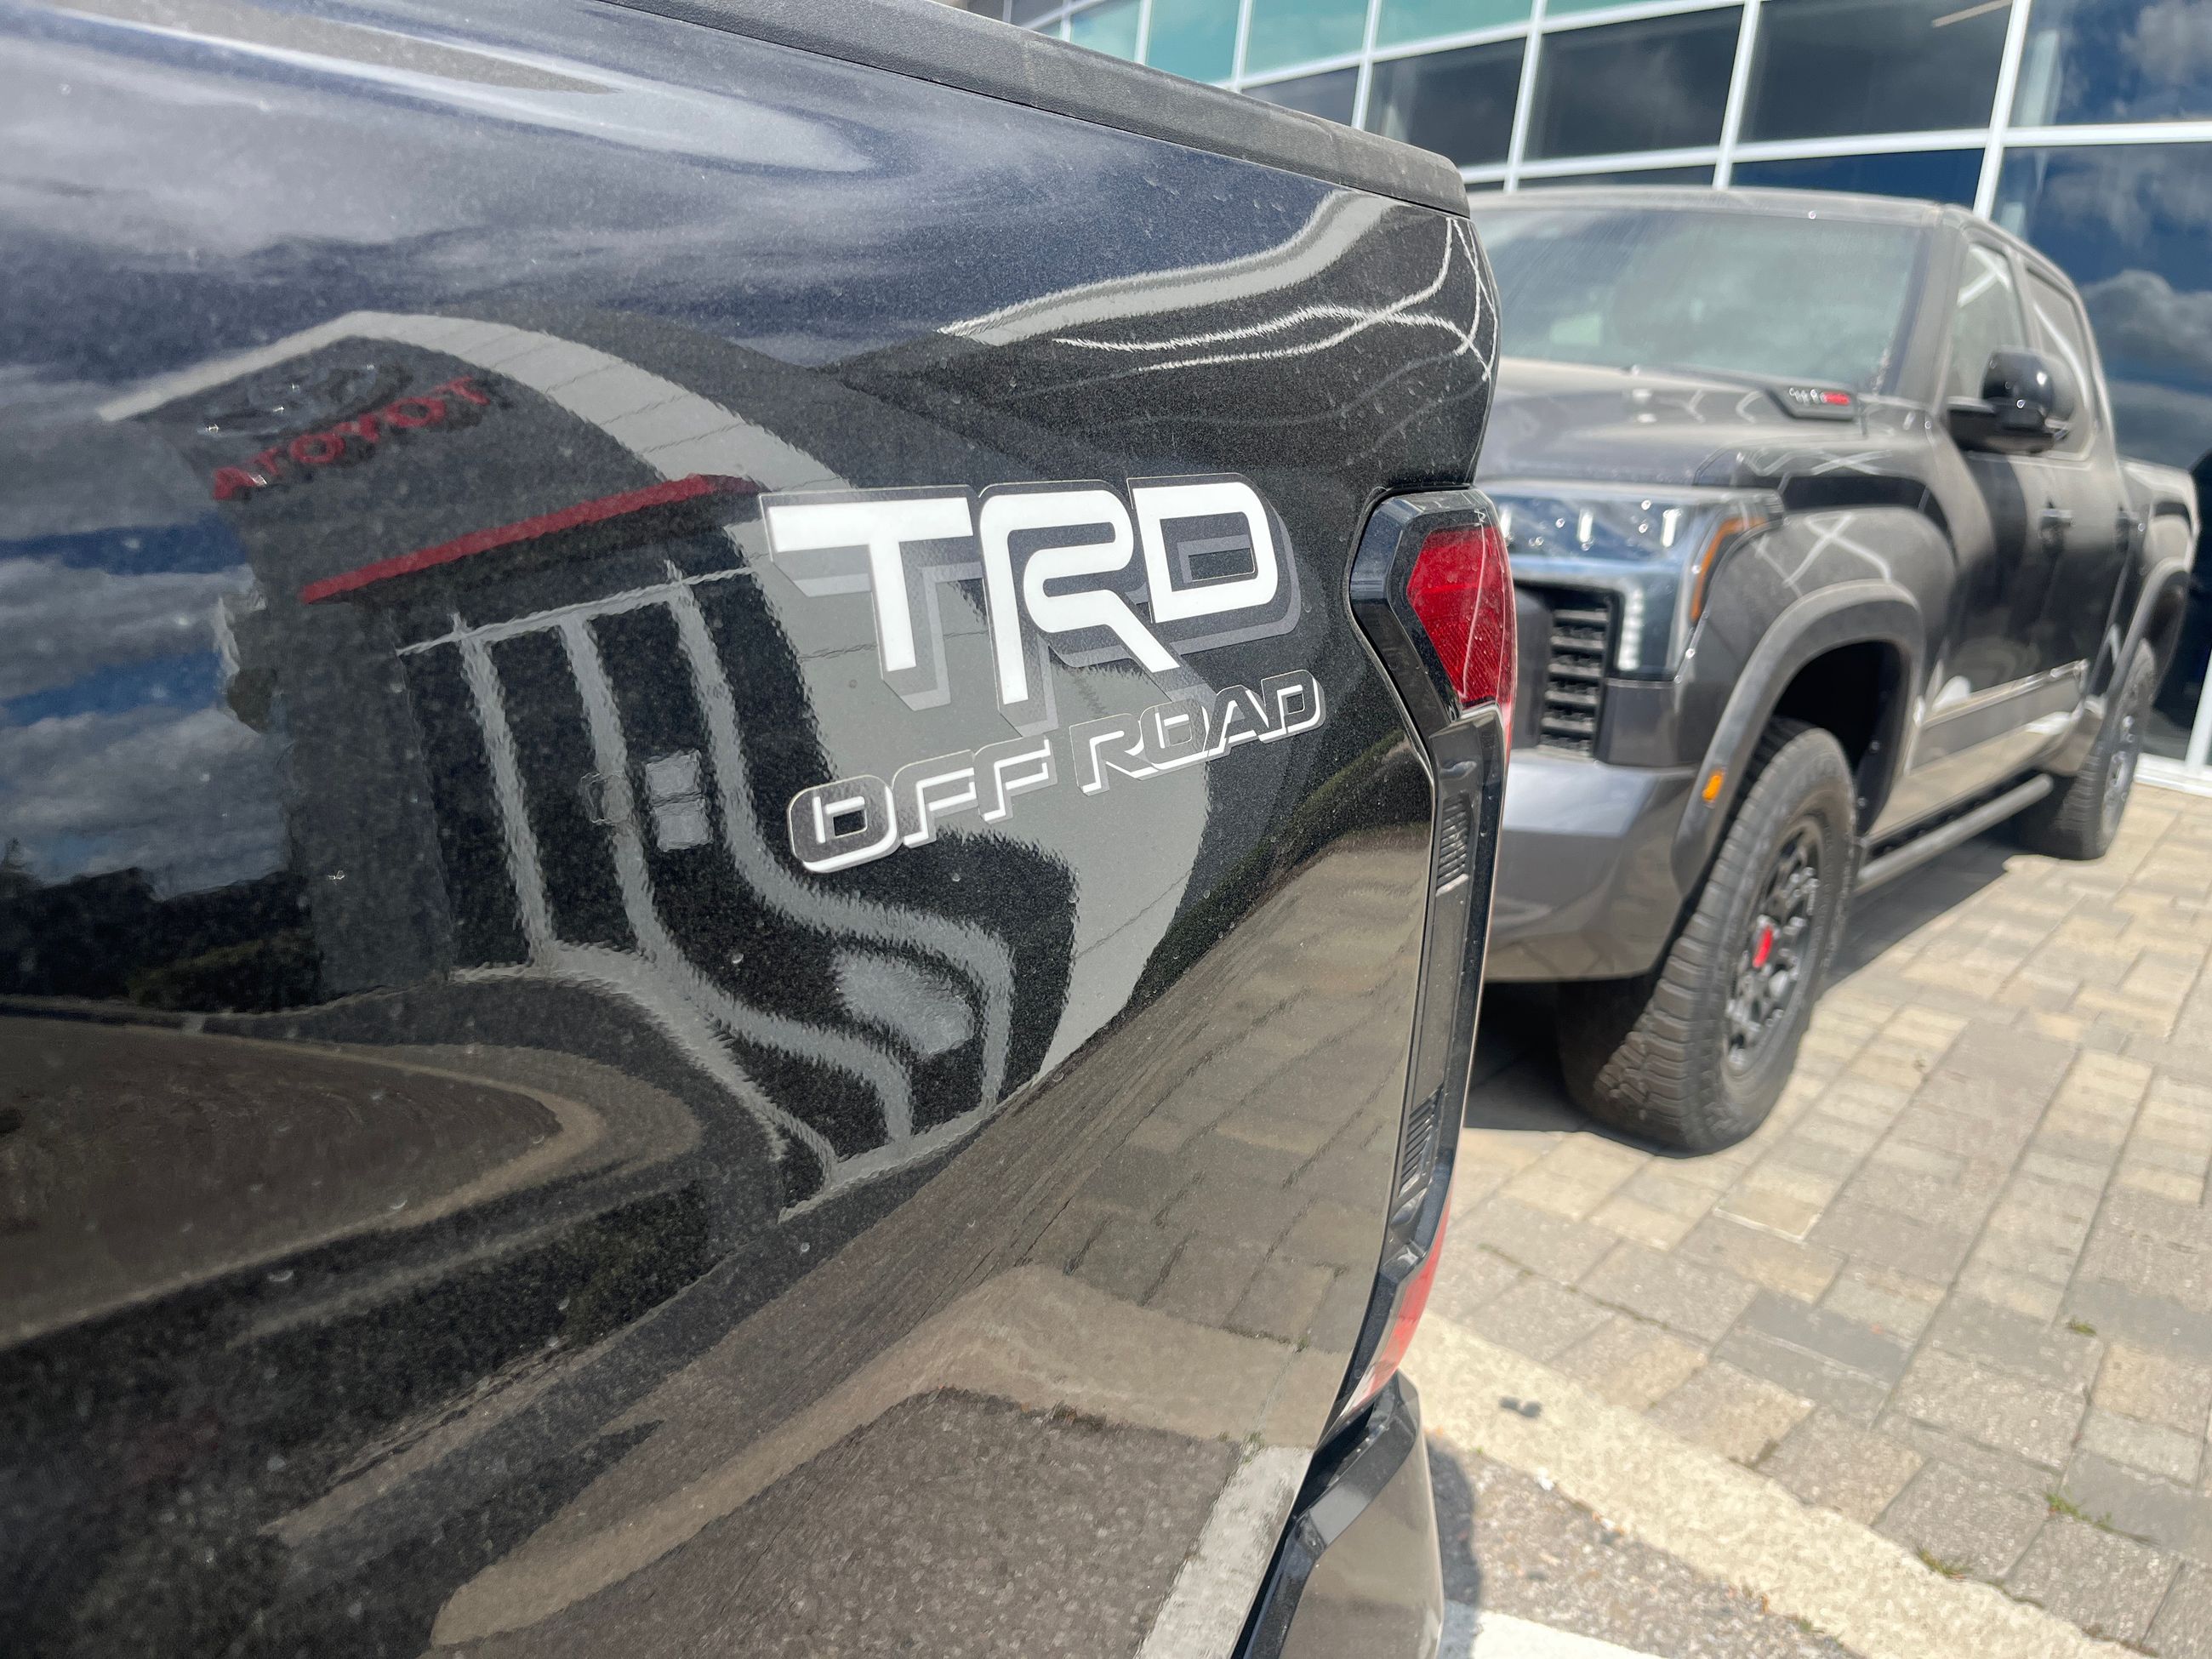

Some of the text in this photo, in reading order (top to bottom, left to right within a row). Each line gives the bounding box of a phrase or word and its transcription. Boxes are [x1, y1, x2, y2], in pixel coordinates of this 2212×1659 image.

[763, 478, 1286, 710] TRD
[787, 670, 1325, 873] OFF ROAD
